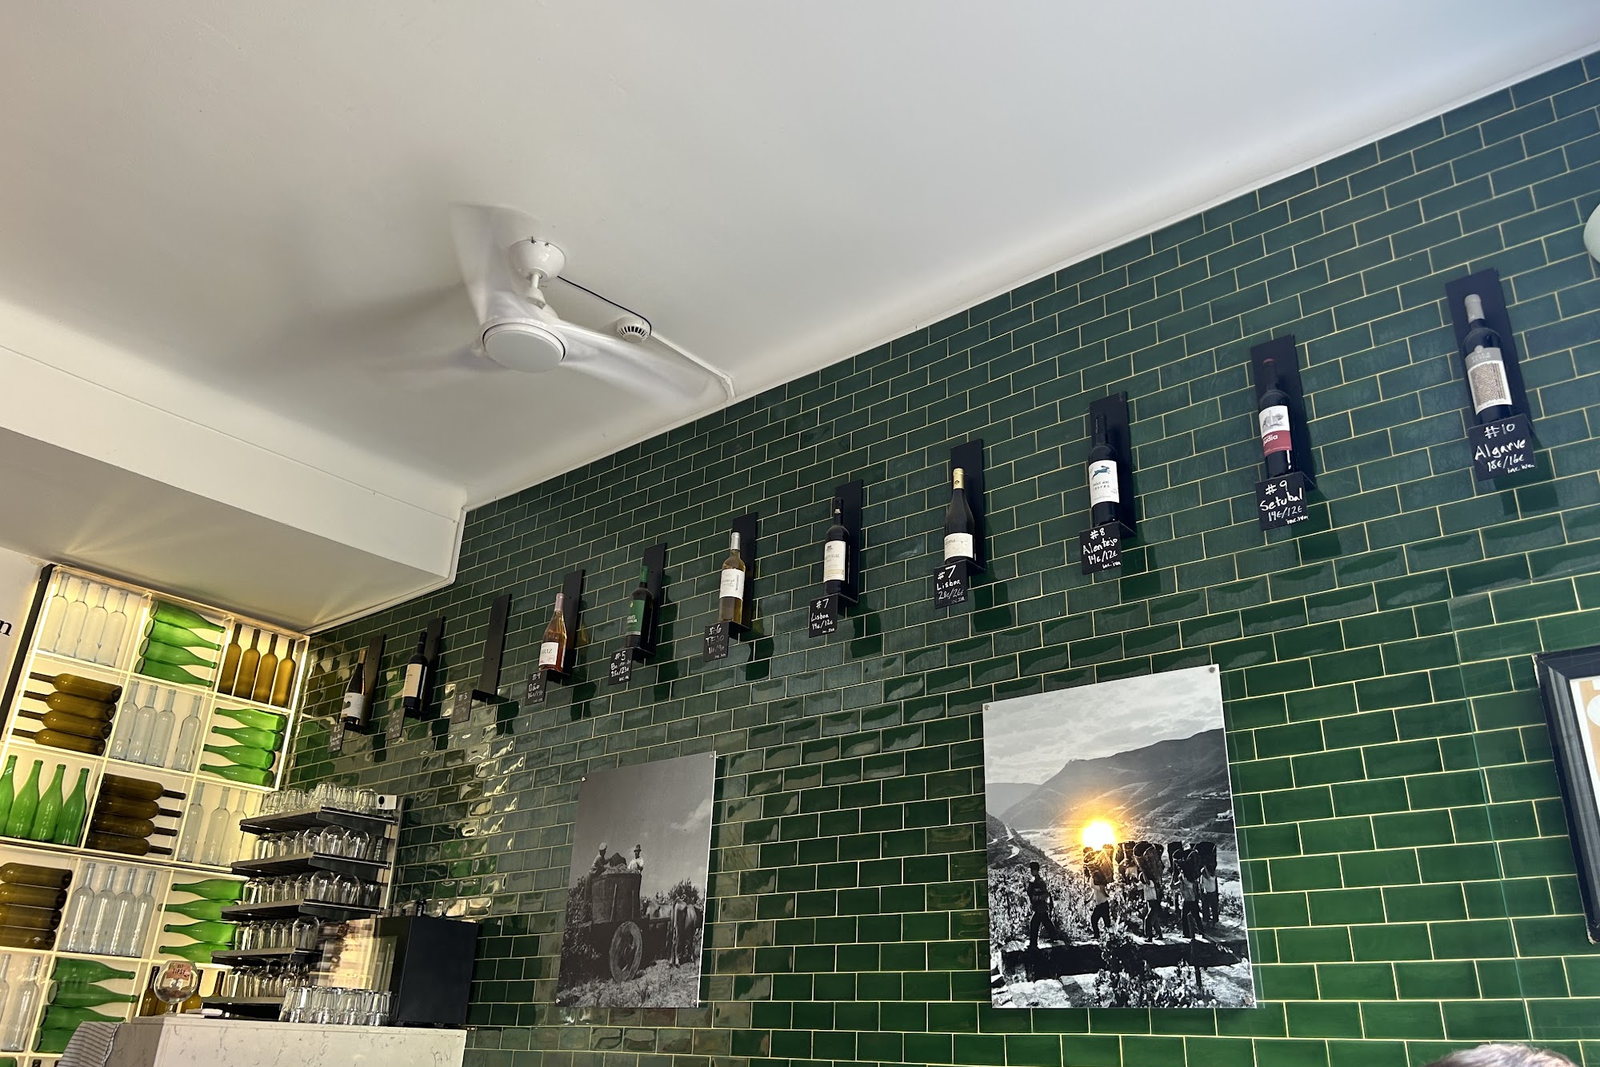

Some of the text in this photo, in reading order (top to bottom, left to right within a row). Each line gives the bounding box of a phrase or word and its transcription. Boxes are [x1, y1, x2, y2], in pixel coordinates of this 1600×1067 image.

[1484, 423, 1516, 439] #10
[1474, 439, 1526, 460] Algarve
[1260, 487, 1303, 511] Setubal
[1090, 527, 1106, 540] #8
[937, 564, 957, 580] #7
[815, 598, 829, 609] #7
